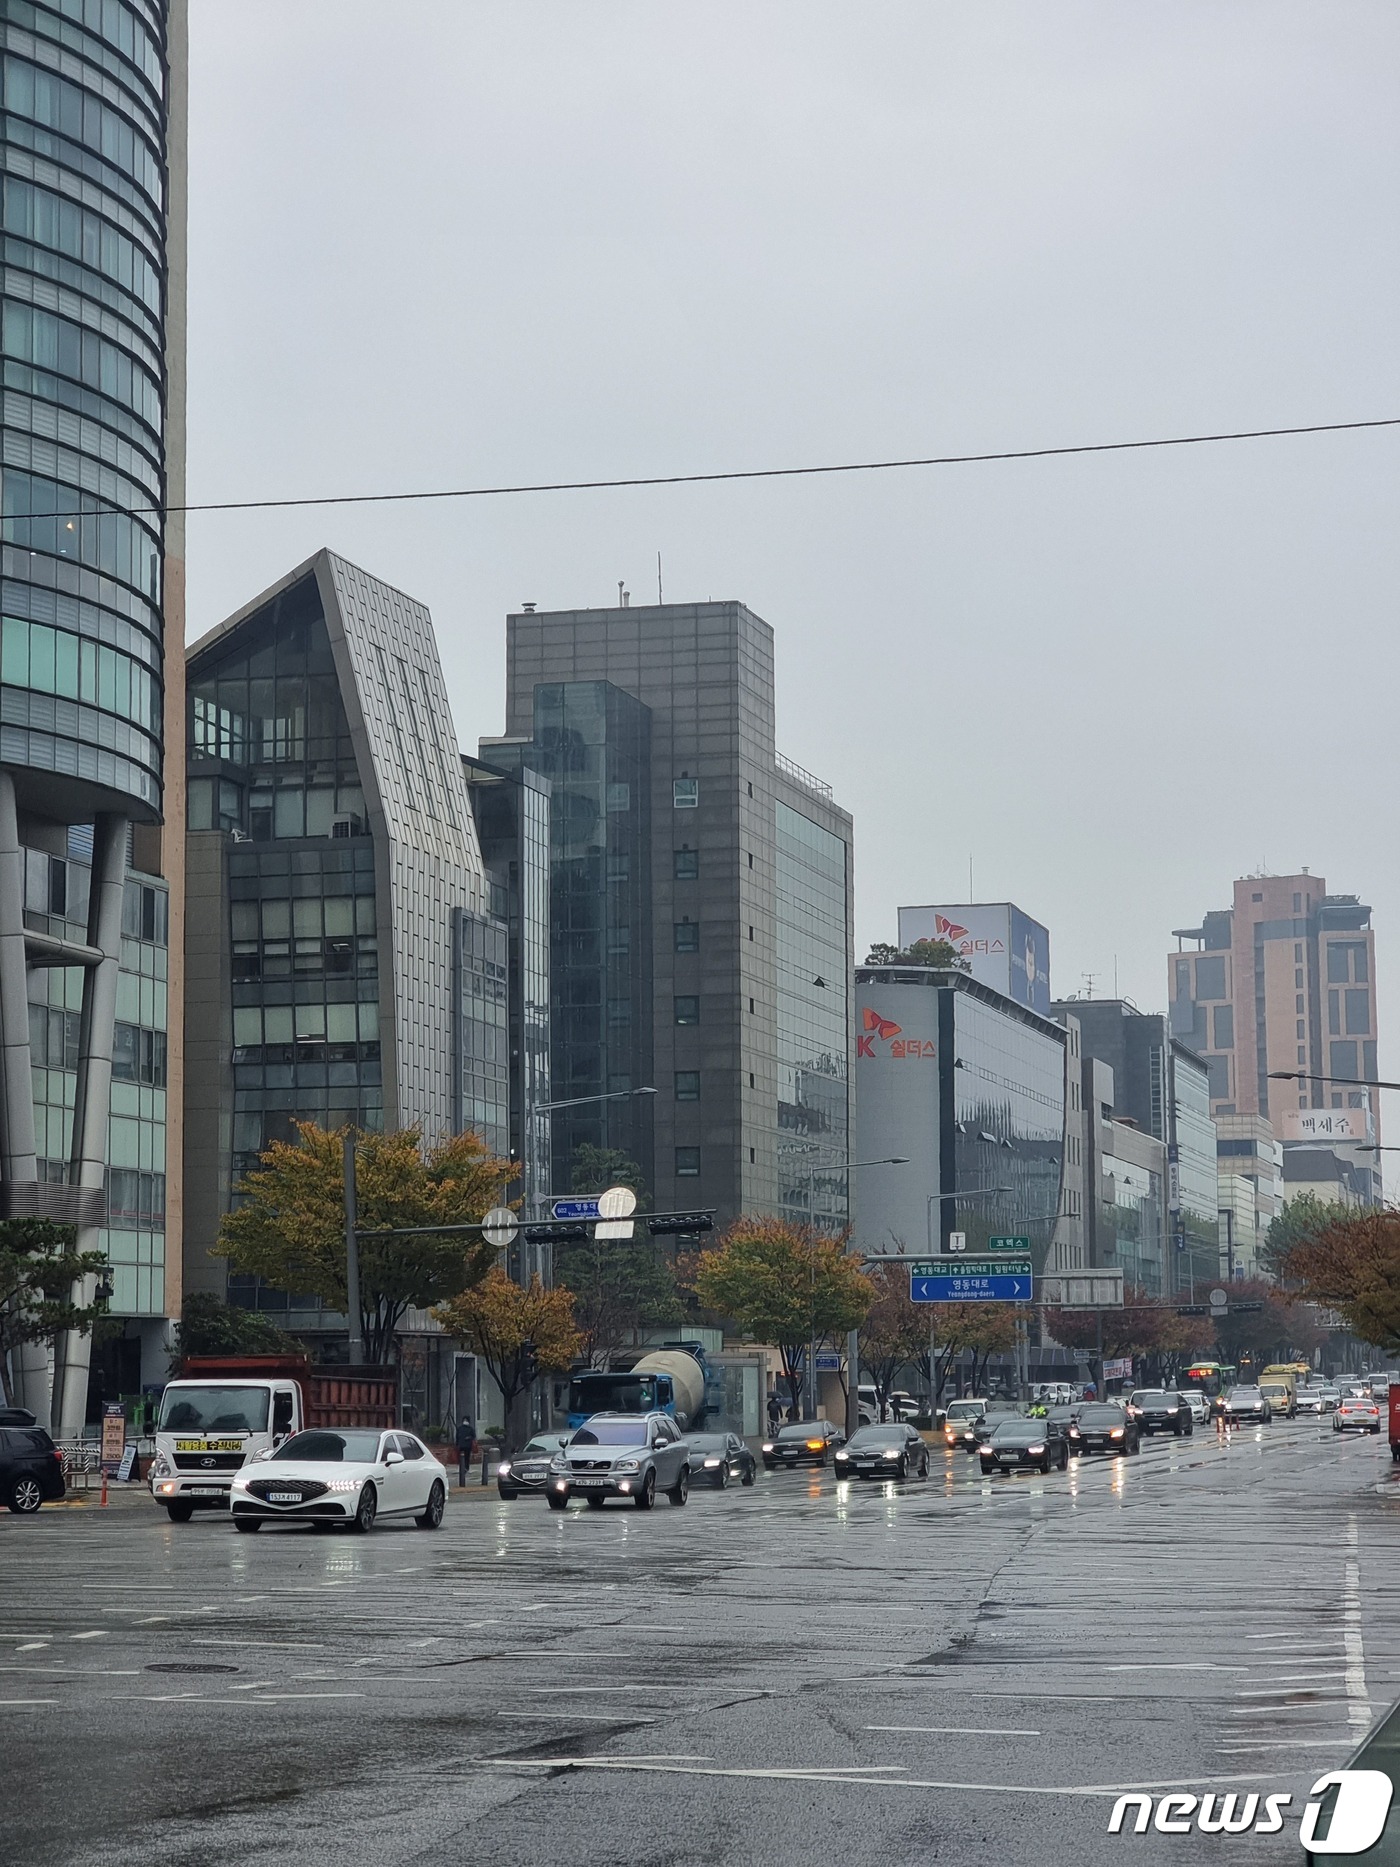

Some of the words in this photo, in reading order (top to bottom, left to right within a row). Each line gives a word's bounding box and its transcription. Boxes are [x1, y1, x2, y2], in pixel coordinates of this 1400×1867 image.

[959, 938, 1005, 956] 쉴더스
[889, 1039, 936, 1058] 쉴더스
[1301, 1116, 1350, 1134] 백세주
[575, 1203, 597, 1211] 영동대
[920, 1265, 948, 1275] 영동대교
[960, 1265, 988, 1275] 올림픽대로
[994, 1264, 1022, 1275] 일원터널
[952, 1279, 989, 1291] 영동대로
[947, 1291, 995, 1299] Yeongdong-daero
